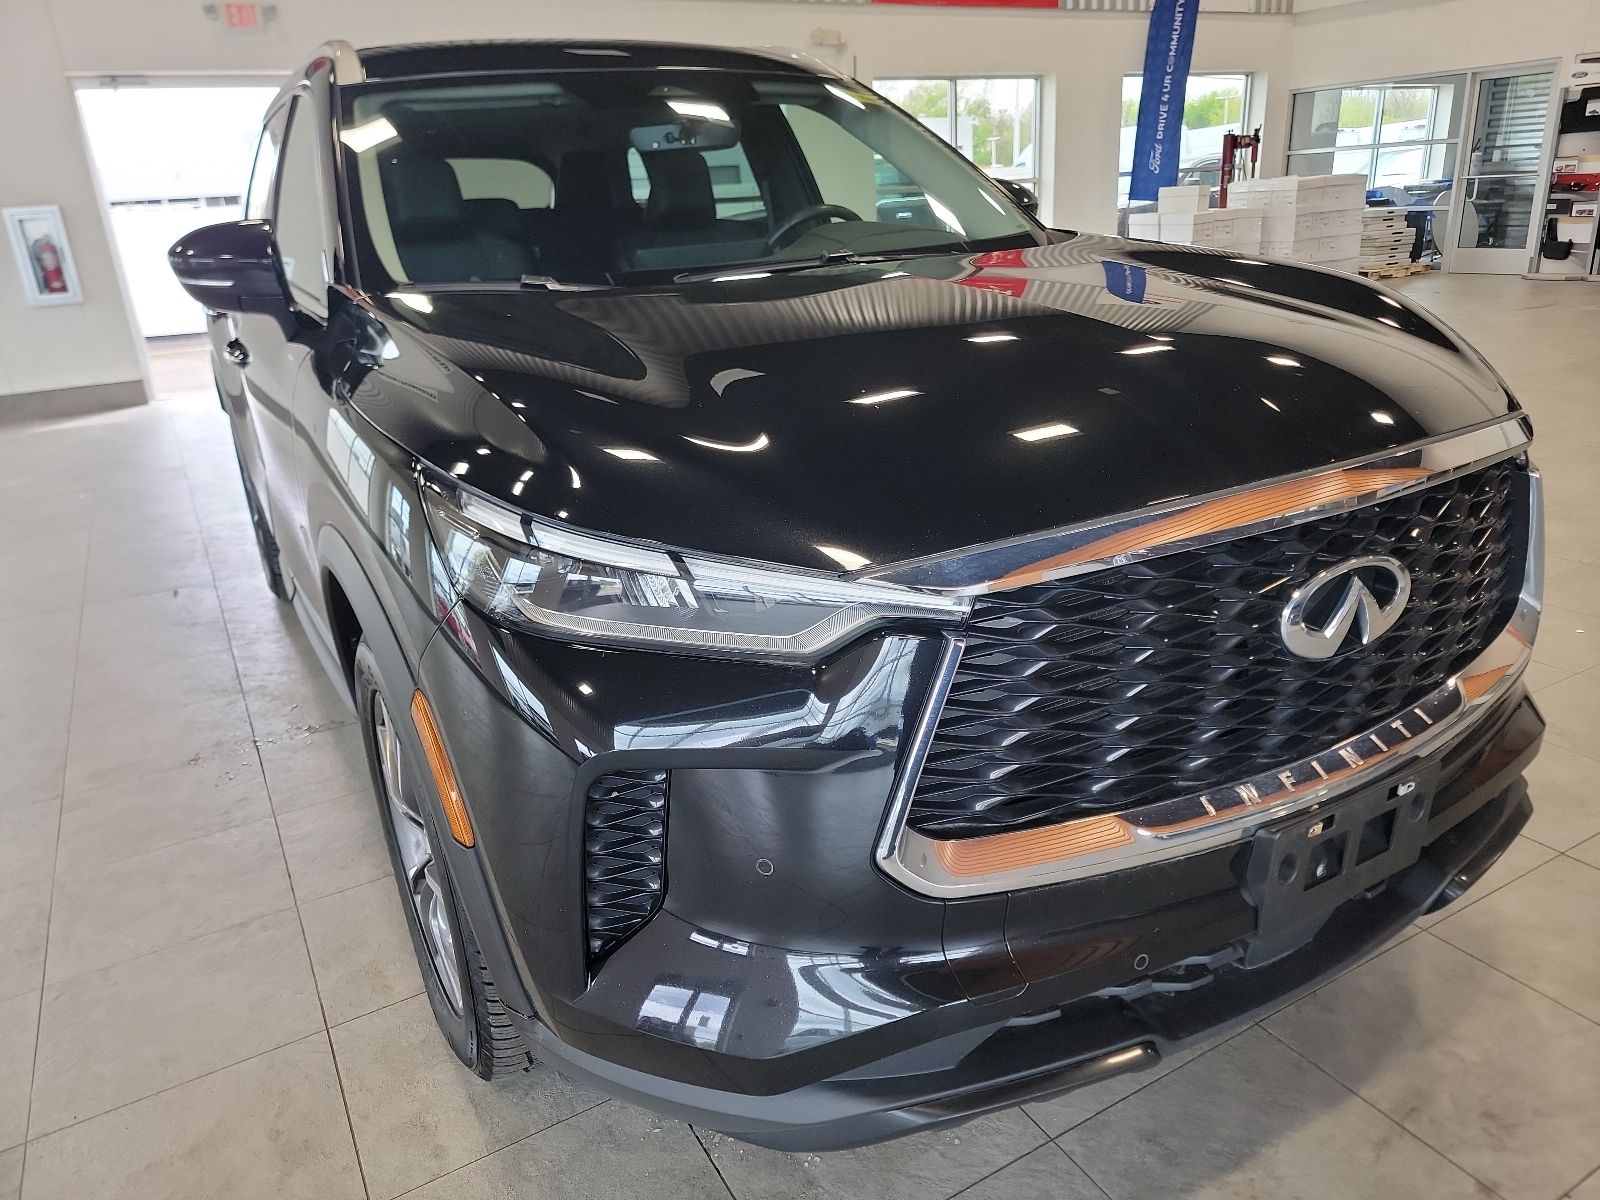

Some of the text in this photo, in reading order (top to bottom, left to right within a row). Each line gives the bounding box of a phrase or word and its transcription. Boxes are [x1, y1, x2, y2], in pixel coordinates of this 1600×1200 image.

[1161, 94, 1170, 102] 4
[1162, 75, 1173, 92] UR
[1156, 104, 1169, 140] DRIVE
[1148, 143, 1163, 174] Ford
[1200, 707, 1433, 817] INFINITI
